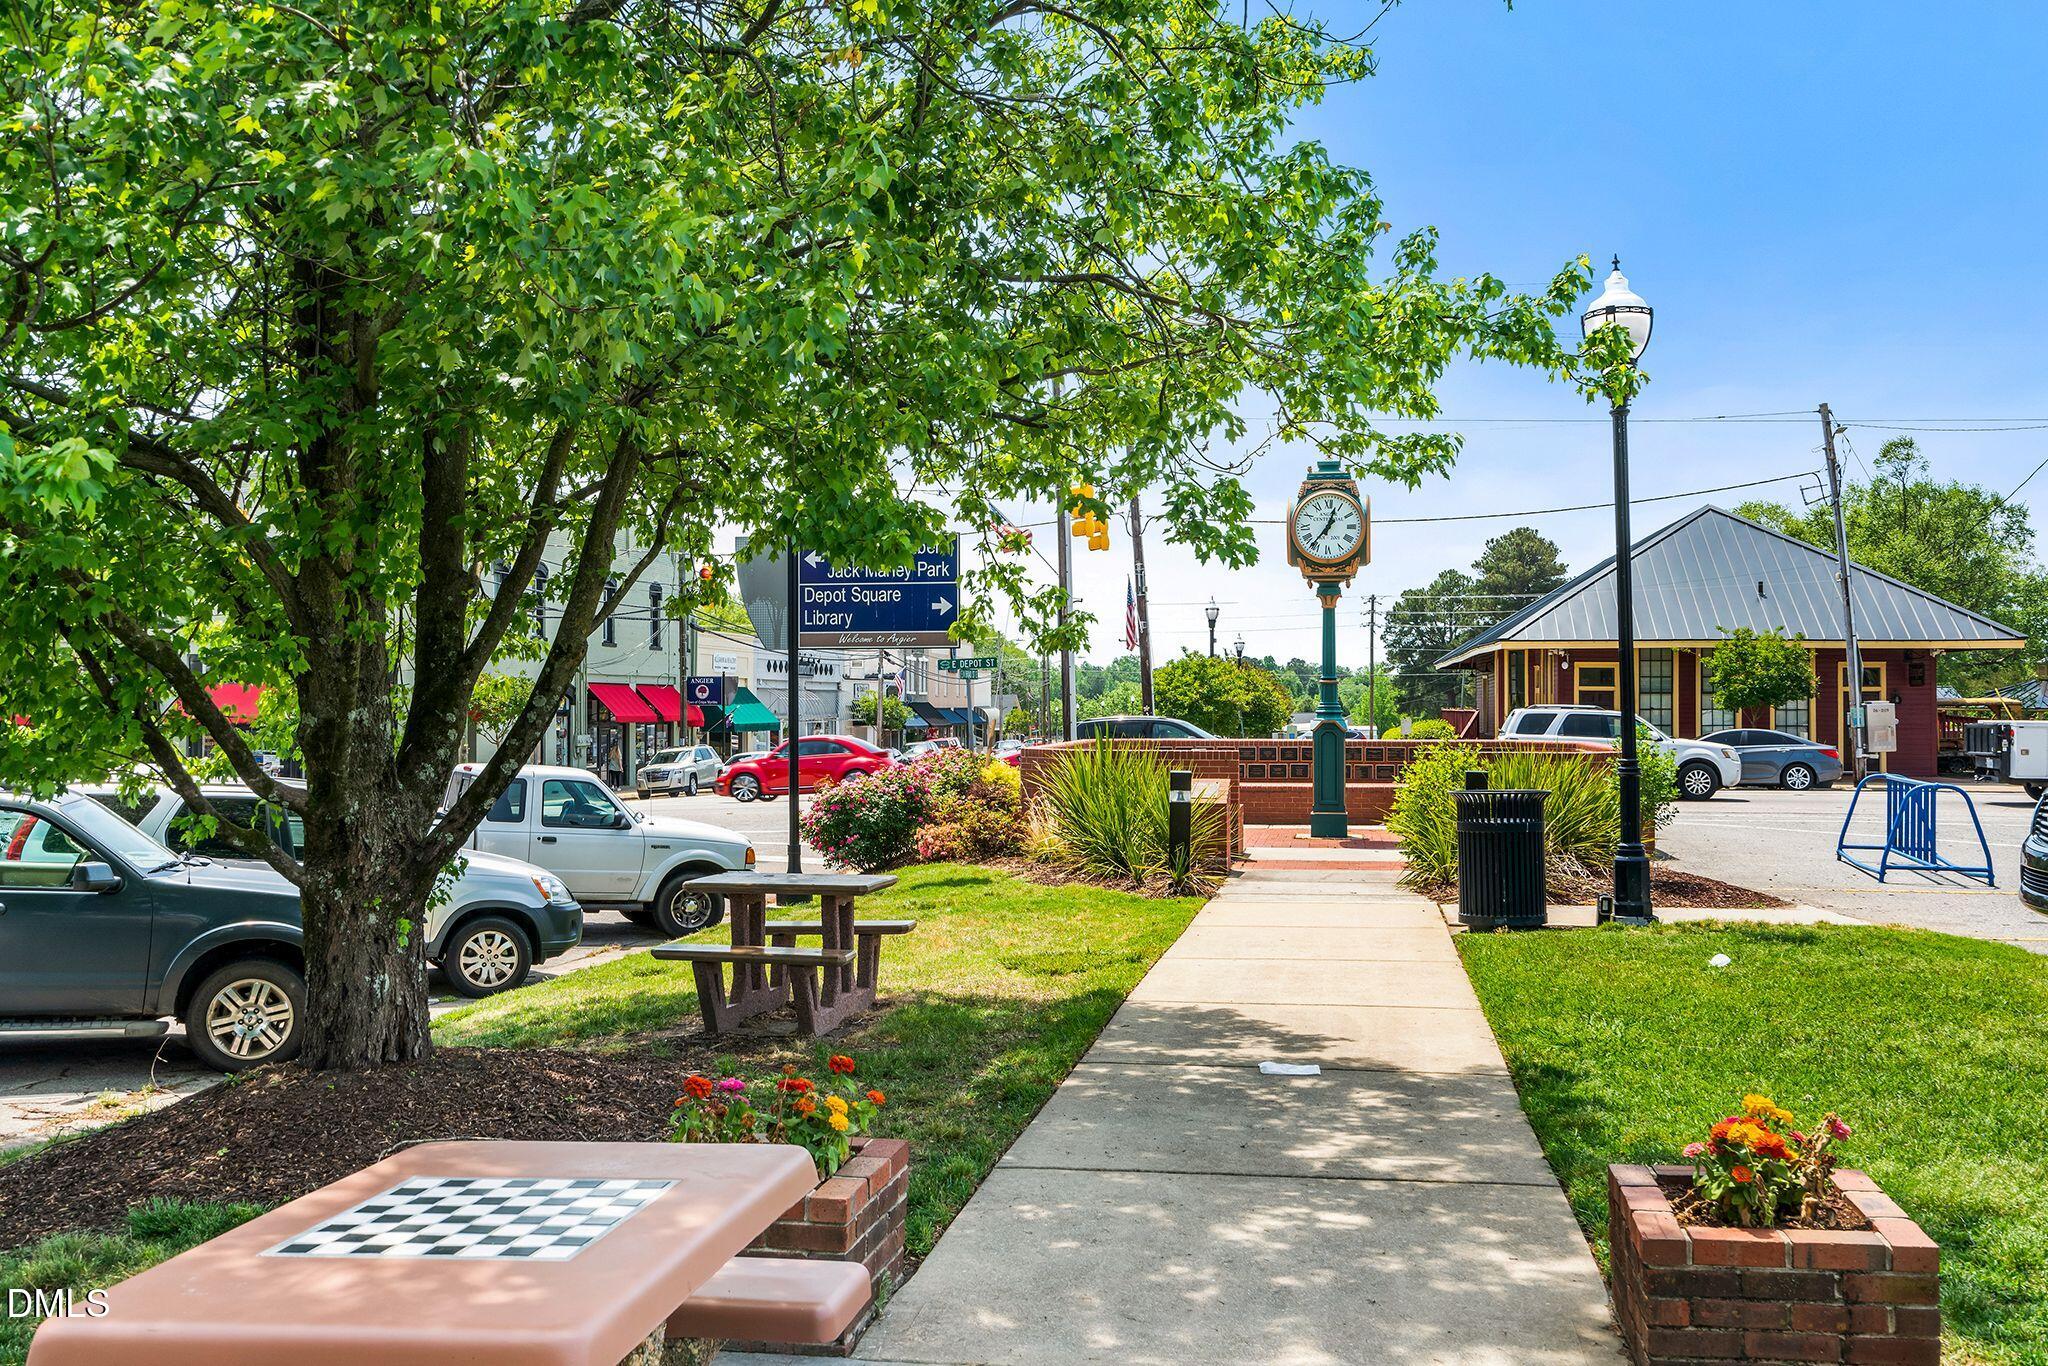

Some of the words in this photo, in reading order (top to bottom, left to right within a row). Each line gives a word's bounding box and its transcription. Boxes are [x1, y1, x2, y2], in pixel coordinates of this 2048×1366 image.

[917, 561, 950, 577] Park
[804, 587, 846, 606] Depot
[851, 586, 901, 605] Square
[804, 609, 853, 629] Library
[839, 632, 873, 644] Welcome
[876, 635, 885, 643] to
[886, 632, 917, 646] Angier
[951, 660, 957, 669] E
[960, 659, 982, 668] DEPOT
[985, 658, 995, 667] ST
